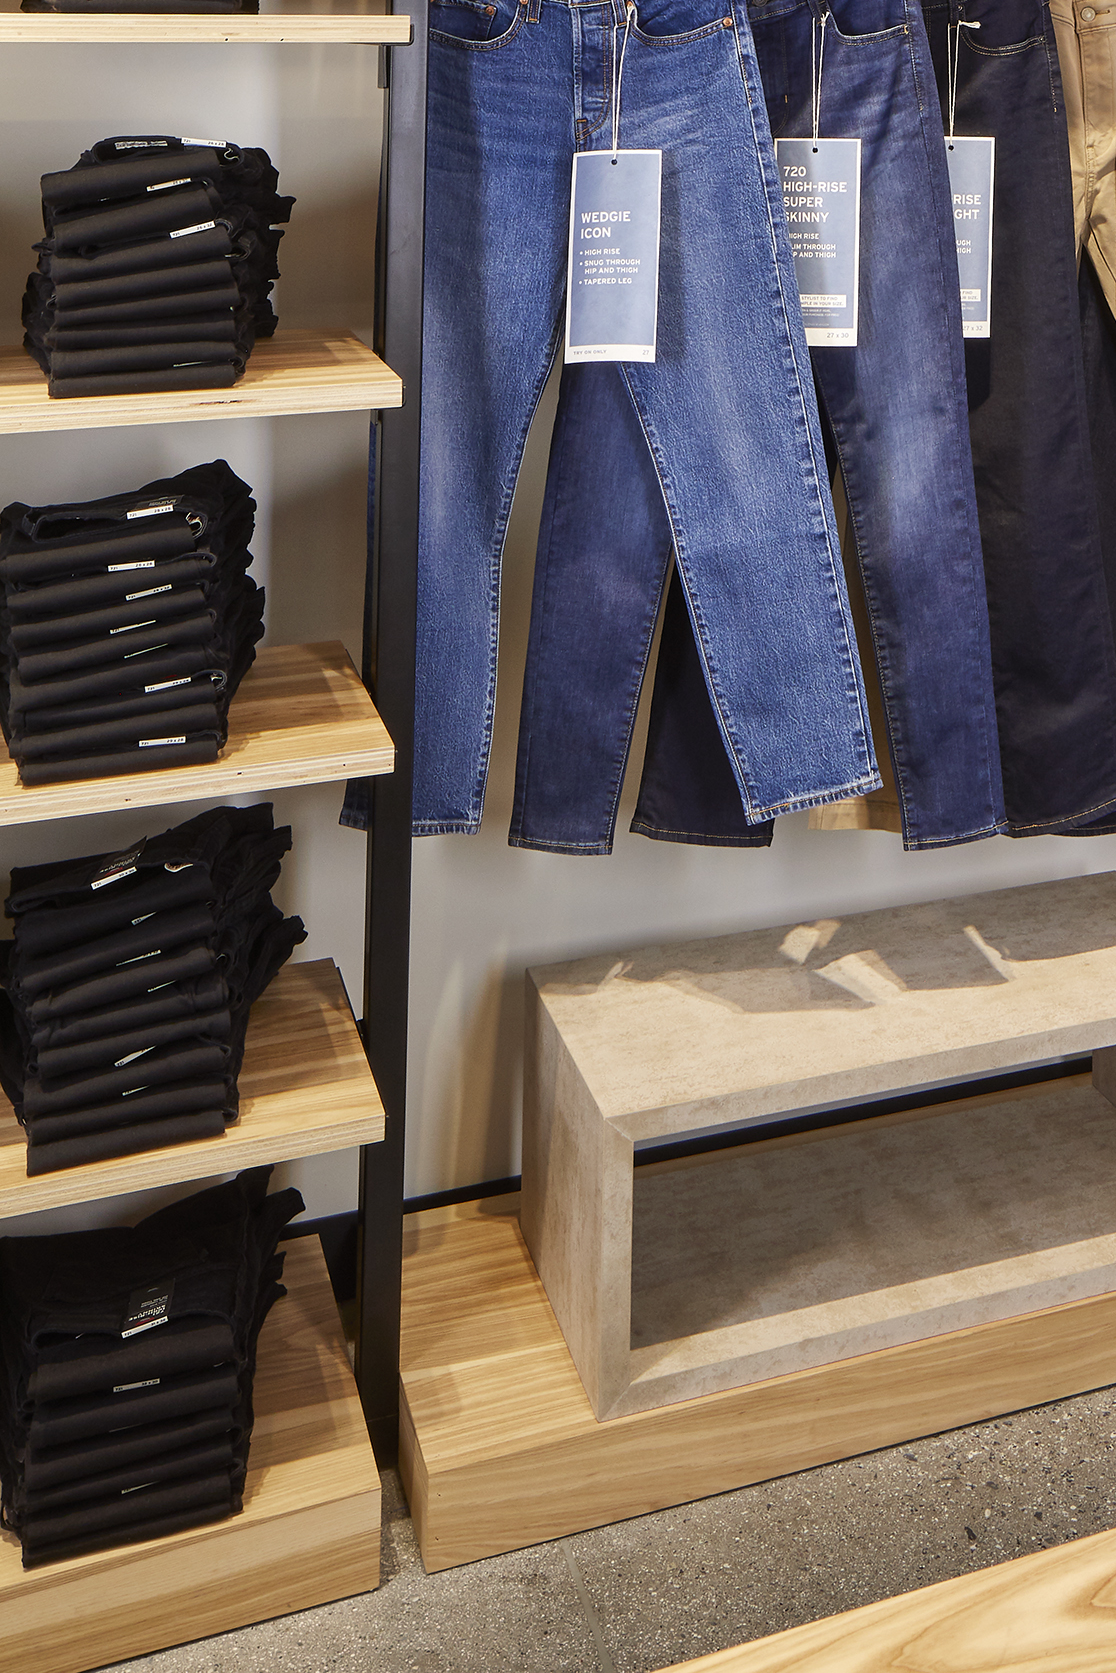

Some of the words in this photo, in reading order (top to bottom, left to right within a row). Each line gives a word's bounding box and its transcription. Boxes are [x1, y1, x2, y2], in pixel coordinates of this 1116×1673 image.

[783, 166, 806, 176] 720
[783, 182, 847, 192] HIGH-RISE
[783, 197, 823, 207] SUPER
[581, 211, 631, 223] WEDGIE
[581, 227, 611, 239] ICON
